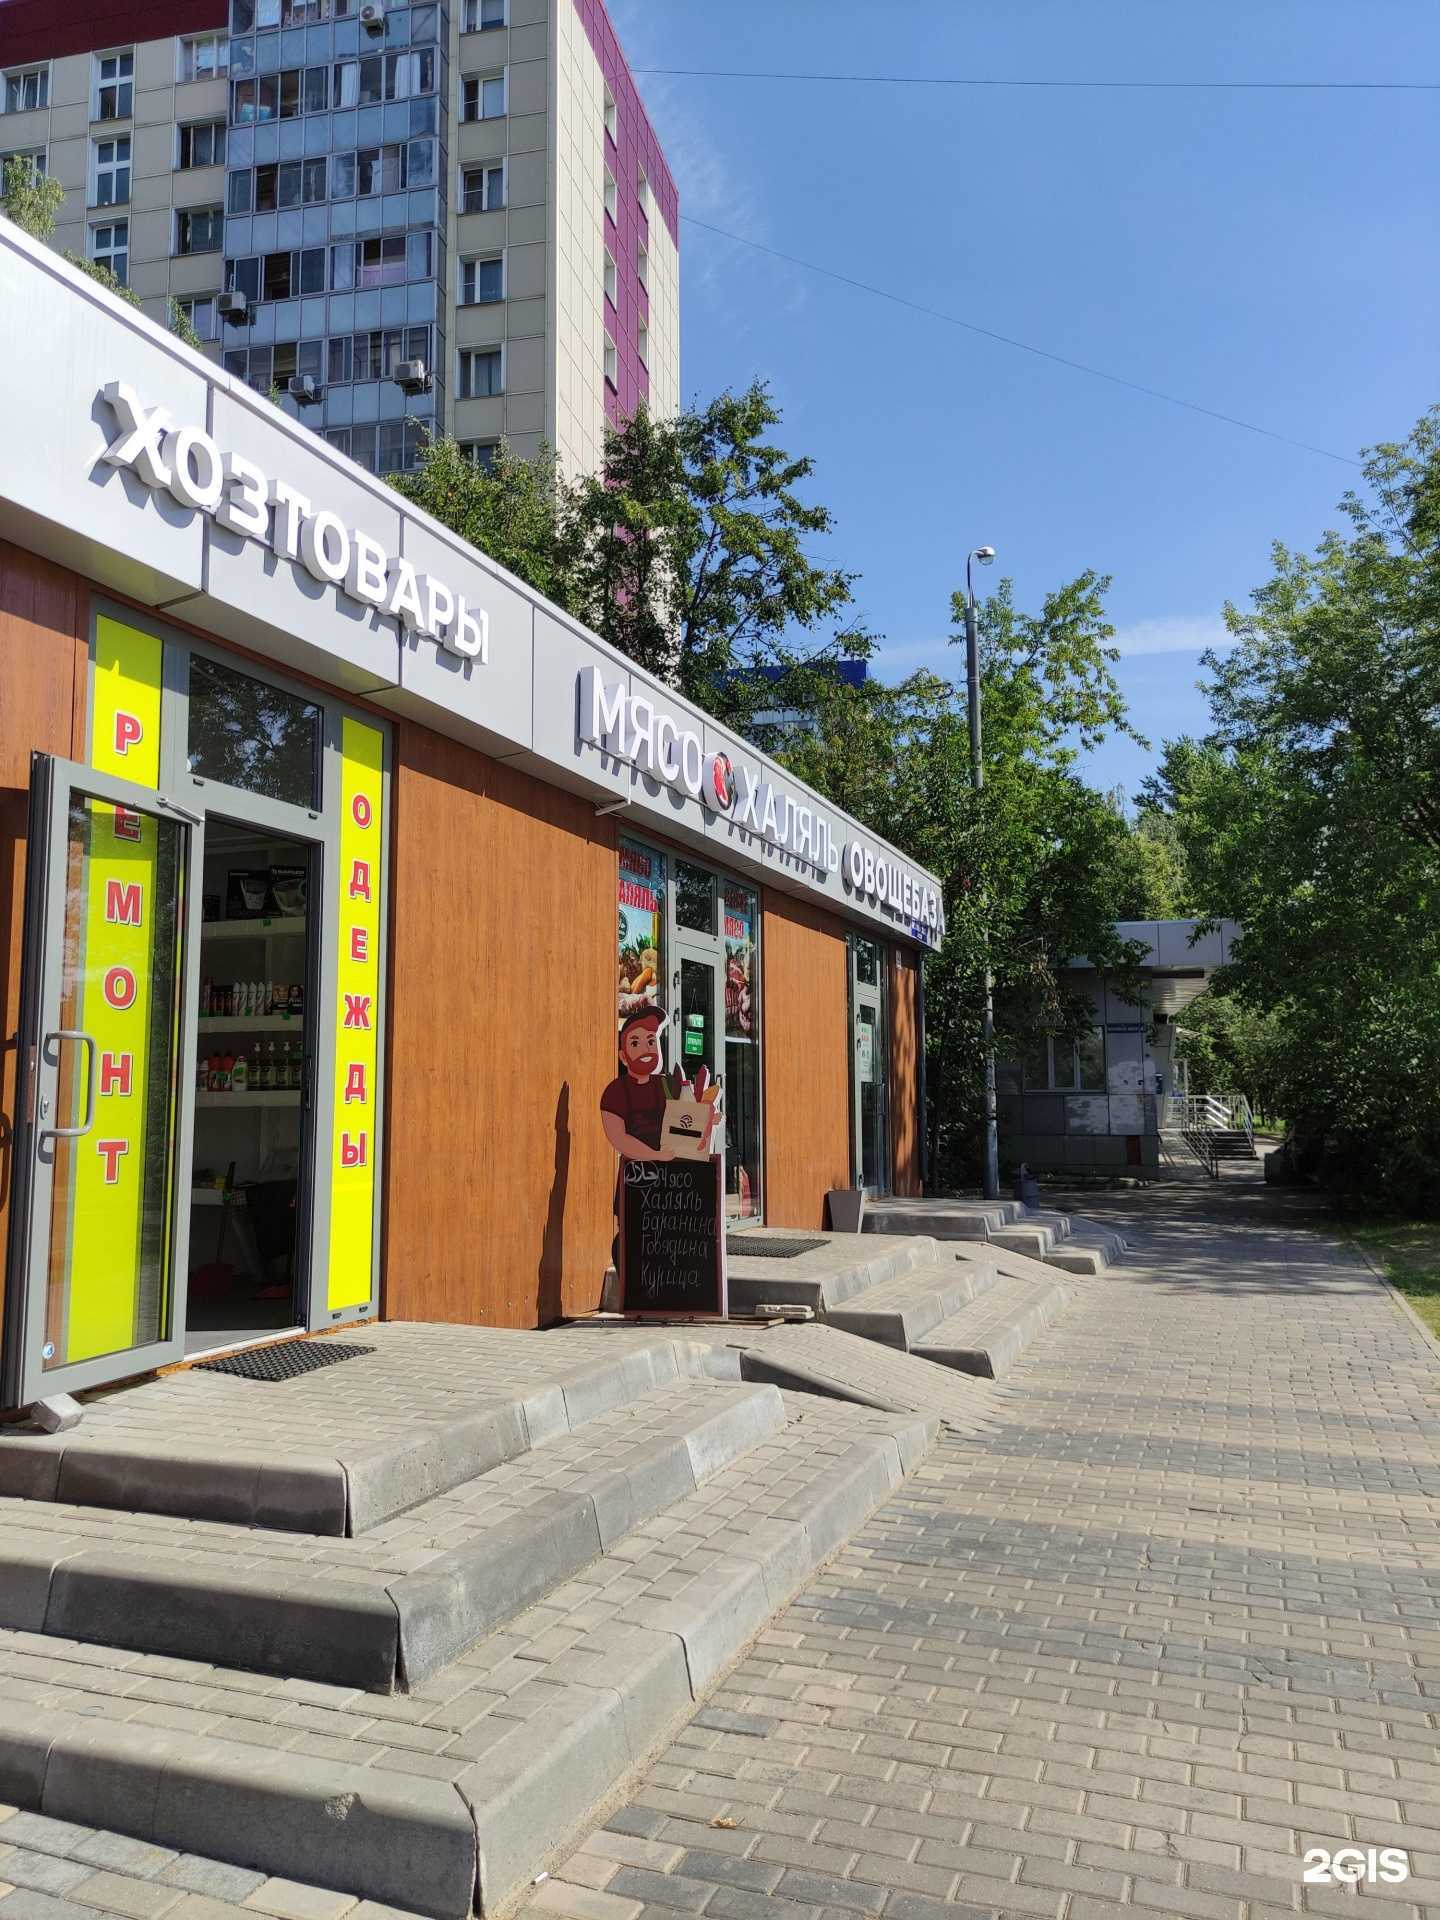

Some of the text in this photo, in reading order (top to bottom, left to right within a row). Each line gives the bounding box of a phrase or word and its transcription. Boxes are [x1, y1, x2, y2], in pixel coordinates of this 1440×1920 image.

[103, 381, 489, 666] ХОЗТОВАРЫ
[580, 665, 946, 936] МЯСО ХАЛЯЛЬ ОВОЩЕБАЗА
[340, 793, 373, 1169] ОДЕЖДЫ
